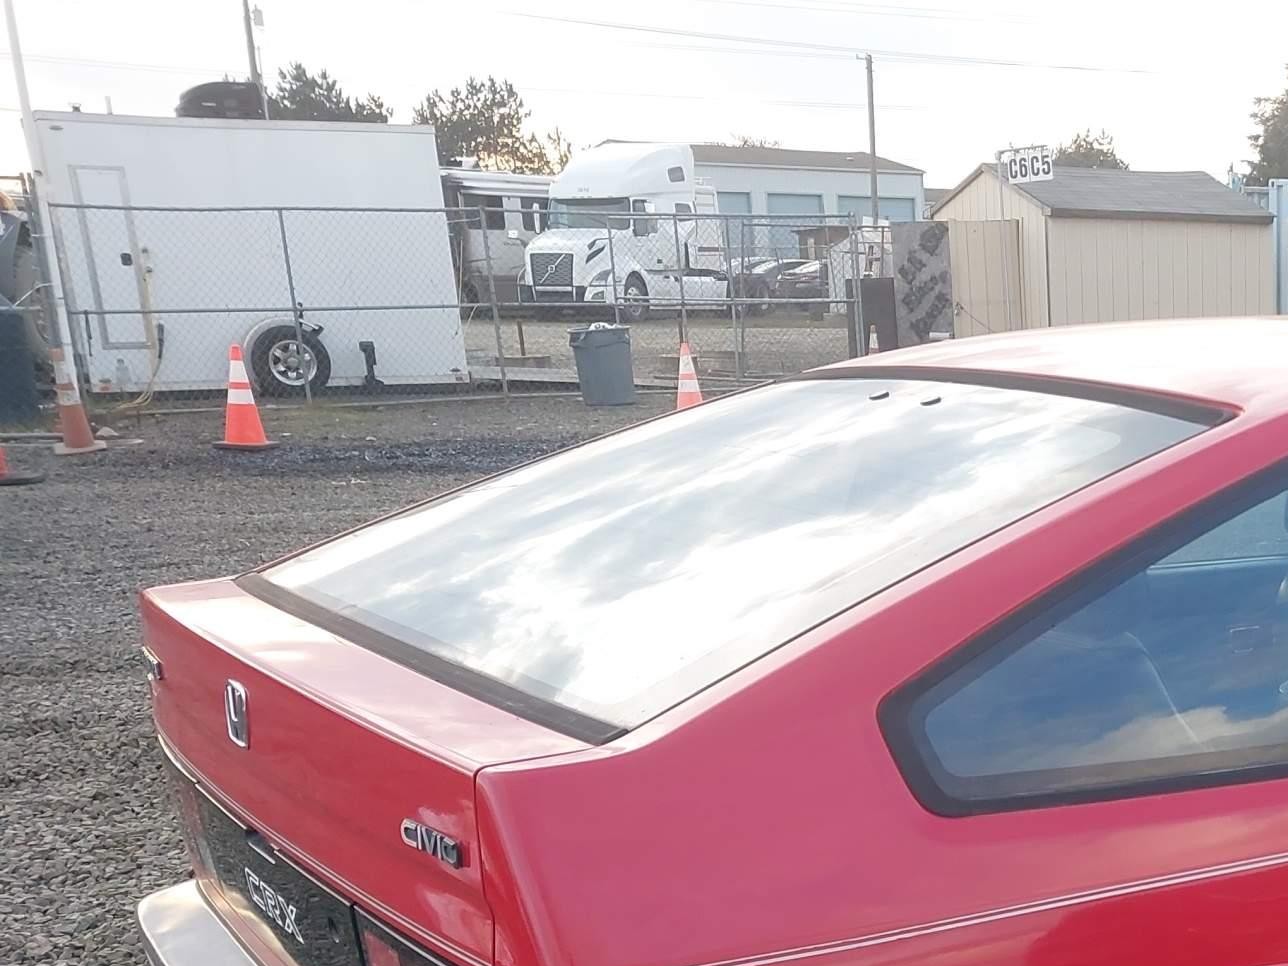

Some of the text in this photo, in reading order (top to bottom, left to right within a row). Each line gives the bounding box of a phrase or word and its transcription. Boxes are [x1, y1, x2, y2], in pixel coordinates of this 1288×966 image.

[1009, 155, 1051, 179] C6 C5
[400, 818, 459, 867] CIVIC
[244, 866, 304, 944] CRX
